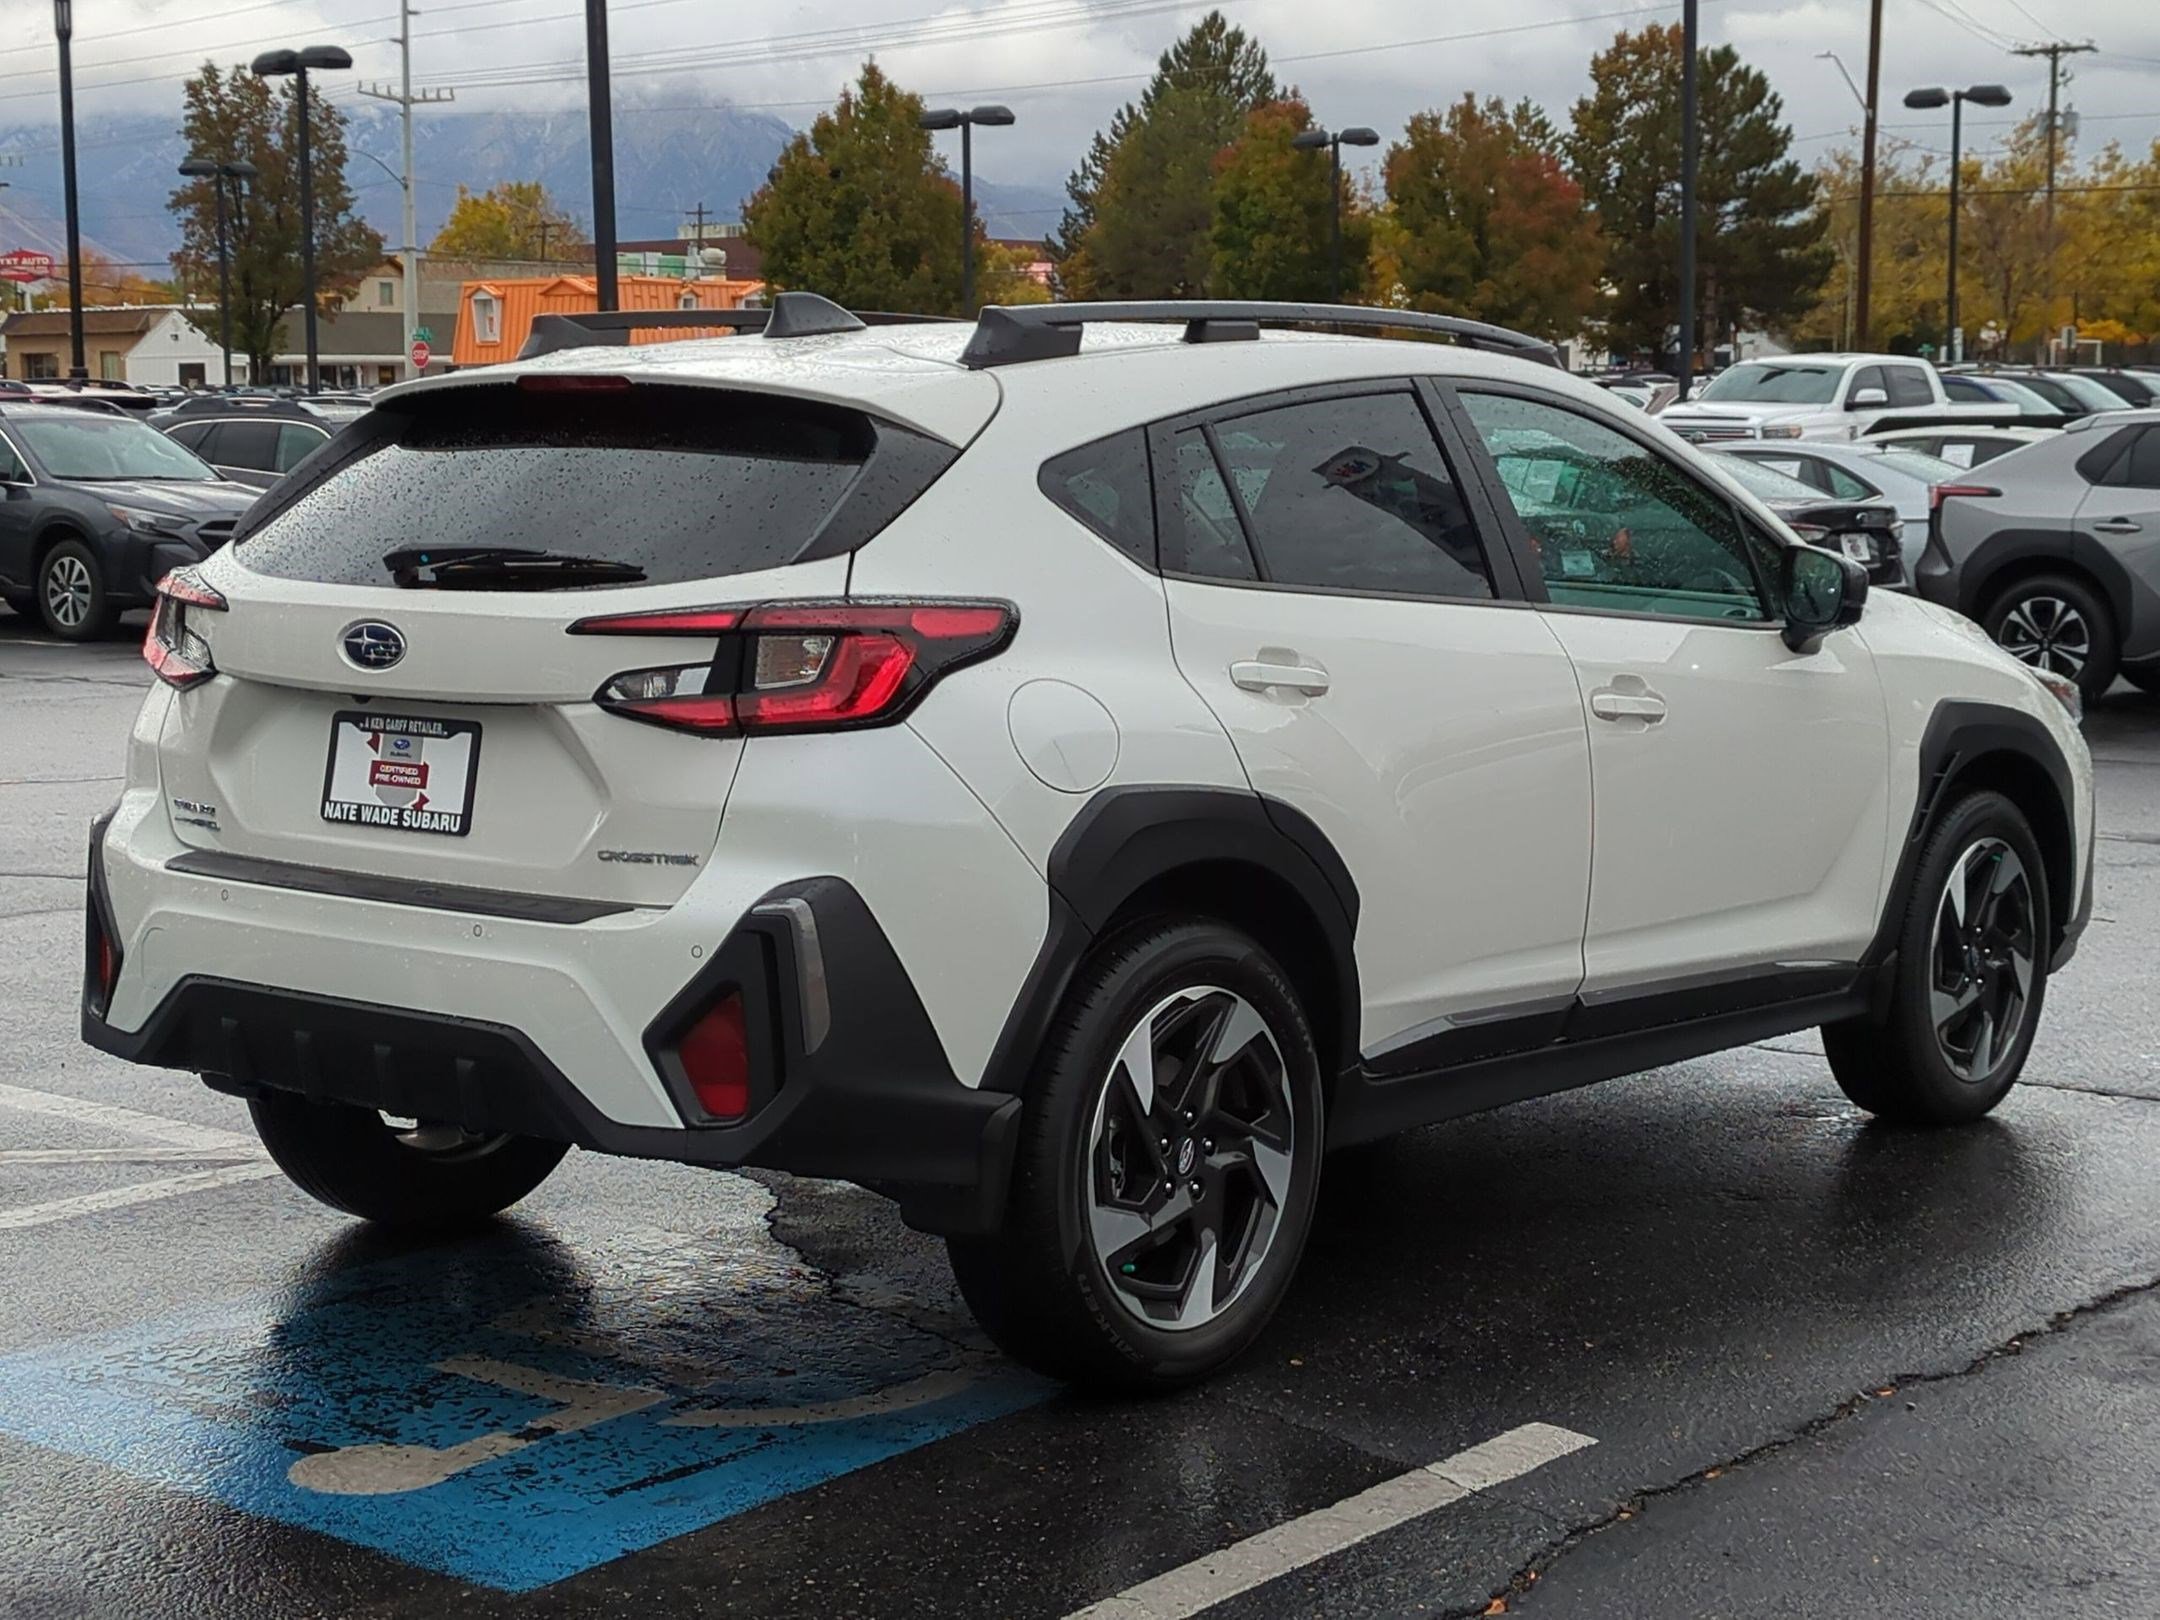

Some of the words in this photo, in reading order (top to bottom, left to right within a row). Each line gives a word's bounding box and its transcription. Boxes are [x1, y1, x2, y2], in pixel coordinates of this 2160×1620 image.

[21, 256, 49, 264] AUTO
[413, 350, 429, 359] STOP
[364, 717, 370, 728] A
[371, 718, 384, 729] KEN
[385, 718, 406, 731] GARFF
[409, 720, 443, 735] RETAILER
[379, 764, 418, 776] CERTIFIED
[375, 773, 421, 785] PRE-OWNED
[324, 801, 357, 821] NATE
[361, 804, 399, 826] WADE
[402, 810, 461, 833] SUBARU
[597, 850, 700, 867] CROSSTREK
